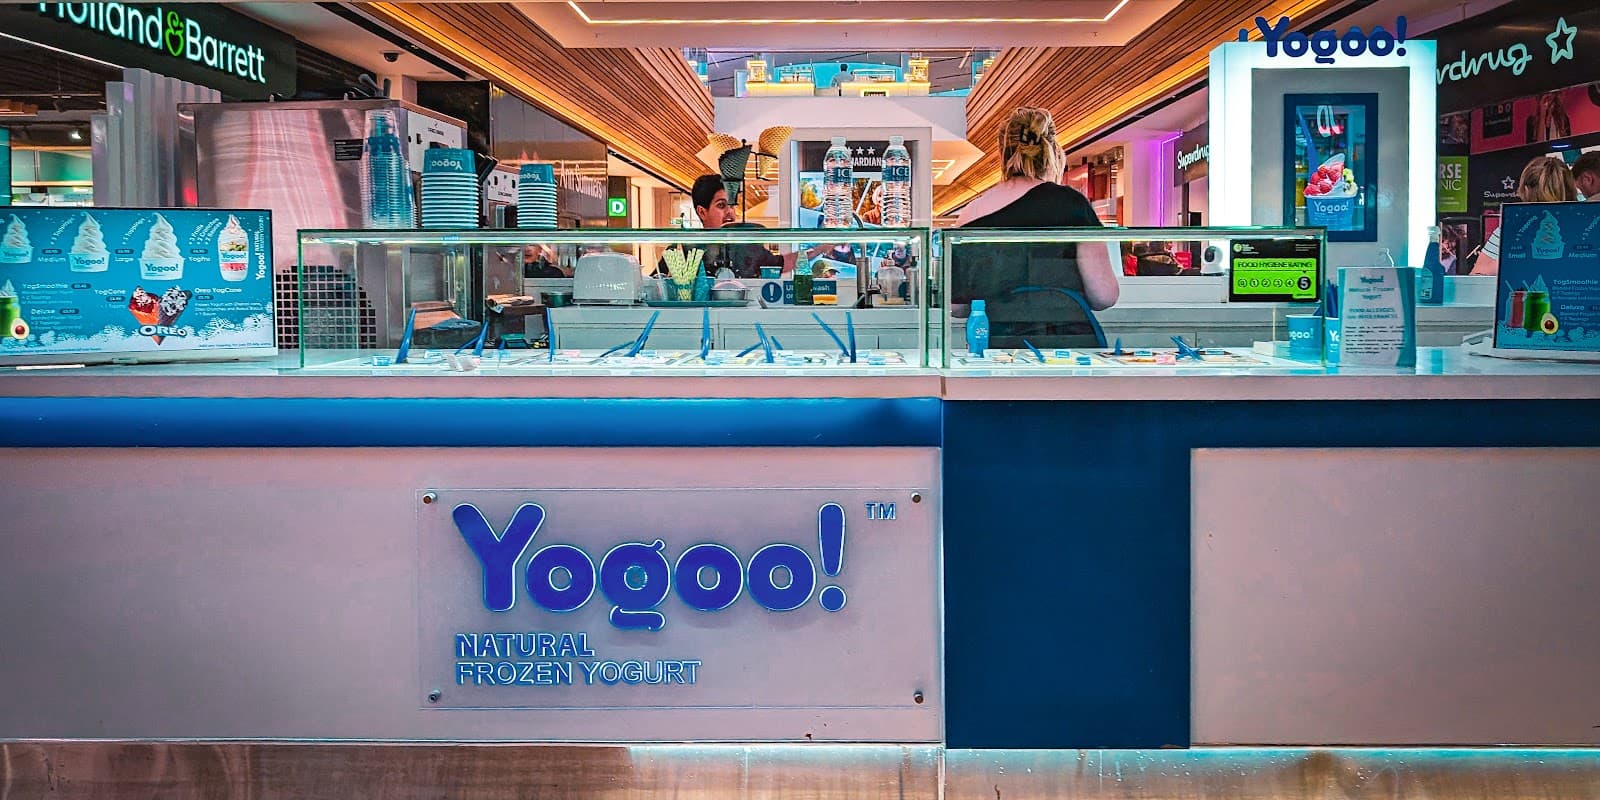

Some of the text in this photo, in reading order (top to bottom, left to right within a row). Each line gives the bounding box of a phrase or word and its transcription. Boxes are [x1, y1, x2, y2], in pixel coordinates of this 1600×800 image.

[1255, 15, 1408, 64] Yogoo!
[186, 18, 266, 84] Barrett
[1177, 143, 1210, 171] Superdrug
[560, 160, 603, 200] Ann Summers
[611, 200, 625, 214] D
[1313, 199, 1349, 214] Yogoo!
[75, 256, 105, 265] Yogoo!
[144, 263, 179, 273] Yogoo!
[255, 252, 267, 280] Yogoo!
[212, 287, 242, 295] YogCone
[1300, 277, 1309, 289] 5
[140, 325, 188, 337] OREO
[865, 501, 897, 520] TM
[452, 502, 848, 631] Yogoo!
[455, 633, 595, 658] NATURAL
[456, 660, 702, 685] FROZEN YOGURT
